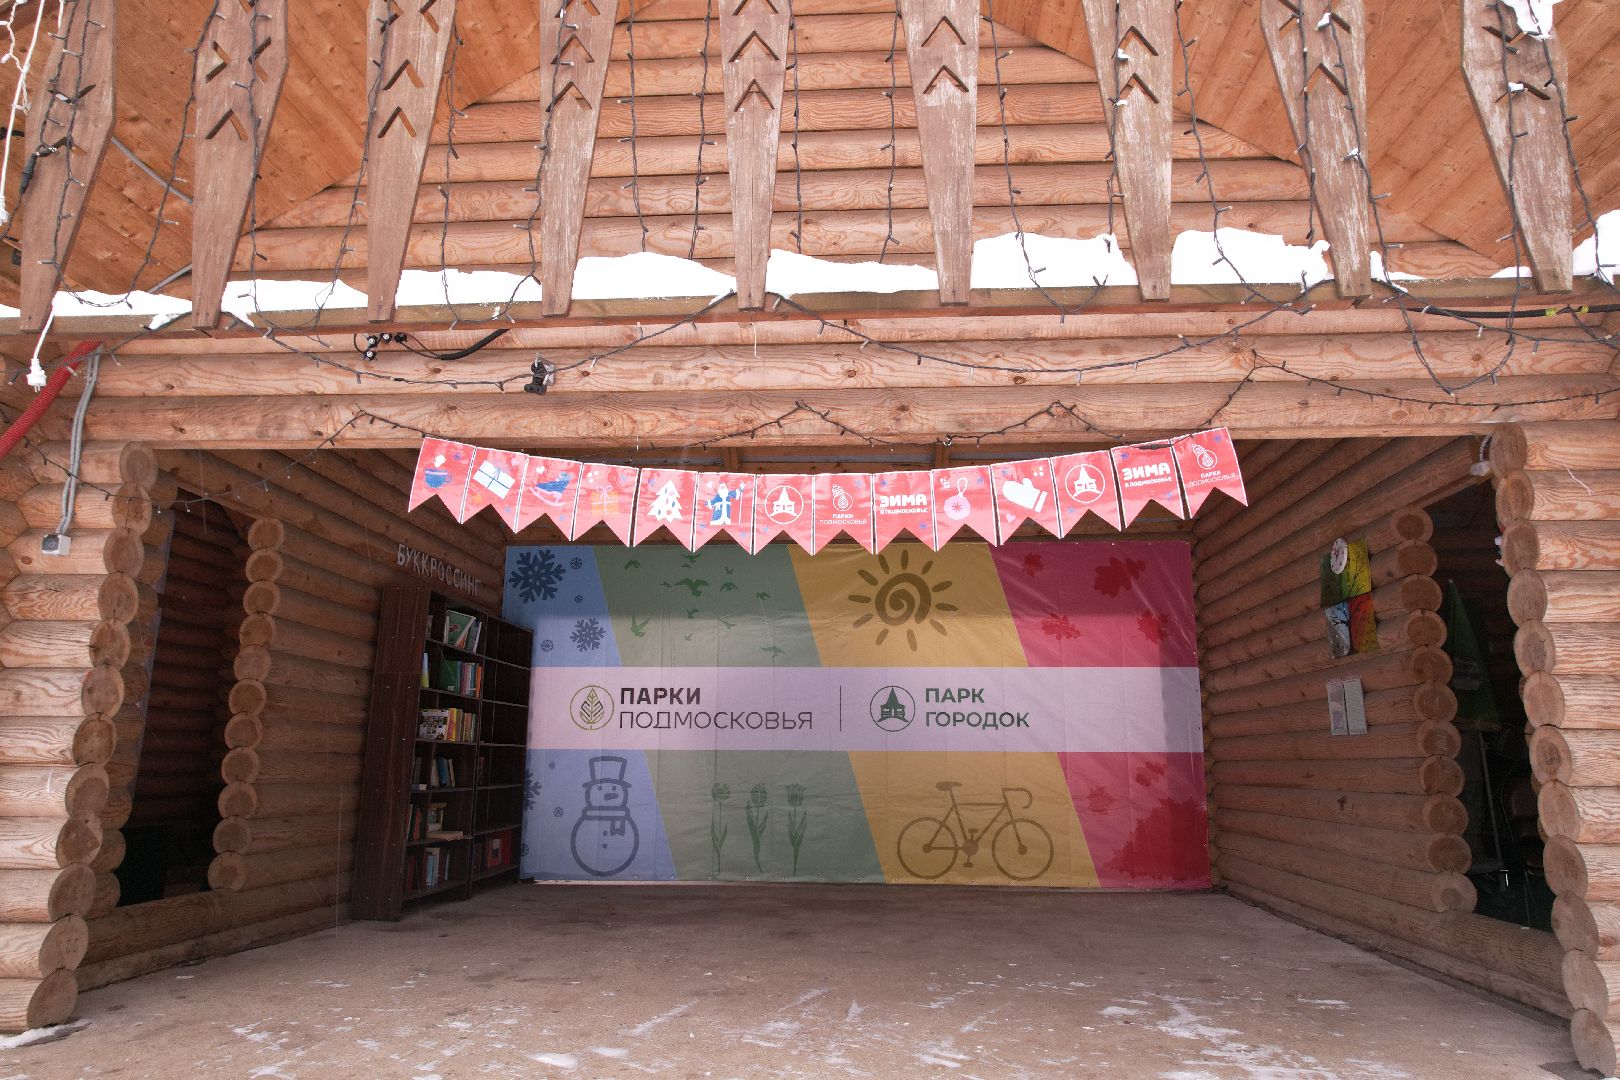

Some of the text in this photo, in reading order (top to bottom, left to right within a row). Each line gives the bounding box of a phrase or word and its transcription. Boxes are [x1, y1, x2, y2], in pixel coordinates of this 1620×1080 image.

[1121, 462, 1171, 481] ЗИМА
[1200, 470, 1222, 479] ПАРКИ
[879, 493, 928, 508] ЗИМА
[397, 543, 482, 597] БУККРОССИНГ
[620, 687, 701, 705] ПАРКИ
[925, 687, 985, 704] ПАРК
[619, 711, 813, 730] ПОДМОСКОВЬЯ
[925, 711, 1030, 730] ГОРОДОК
